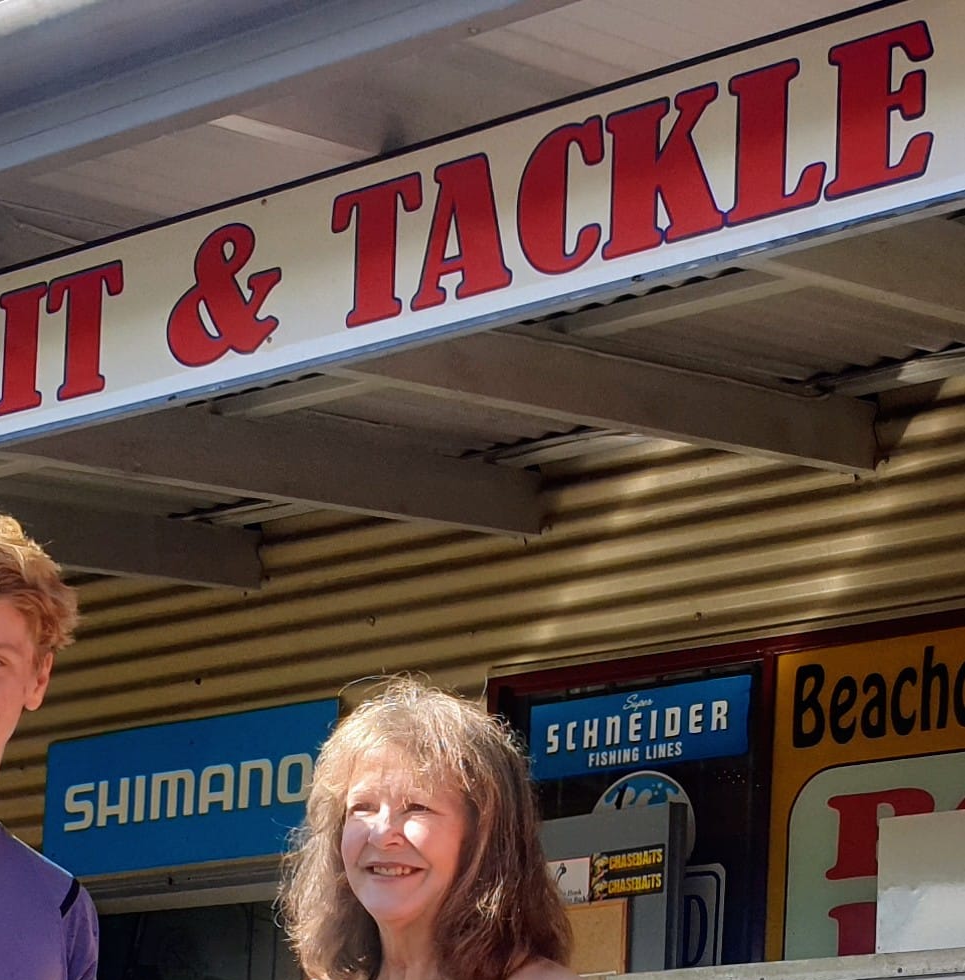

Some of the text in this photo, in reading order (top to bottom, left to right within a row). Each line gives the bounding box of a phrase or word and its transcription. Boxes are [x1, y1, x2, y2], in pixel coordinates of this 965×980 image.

[166, 223, 282, 368] &
[331, 19, 934, 330] TACKLE
[546, 699, 729, 754] SCHNEIDER
[588, 741, 683, 768] FISHING LINES
[63, 752, 313, 832] SHIMANO
